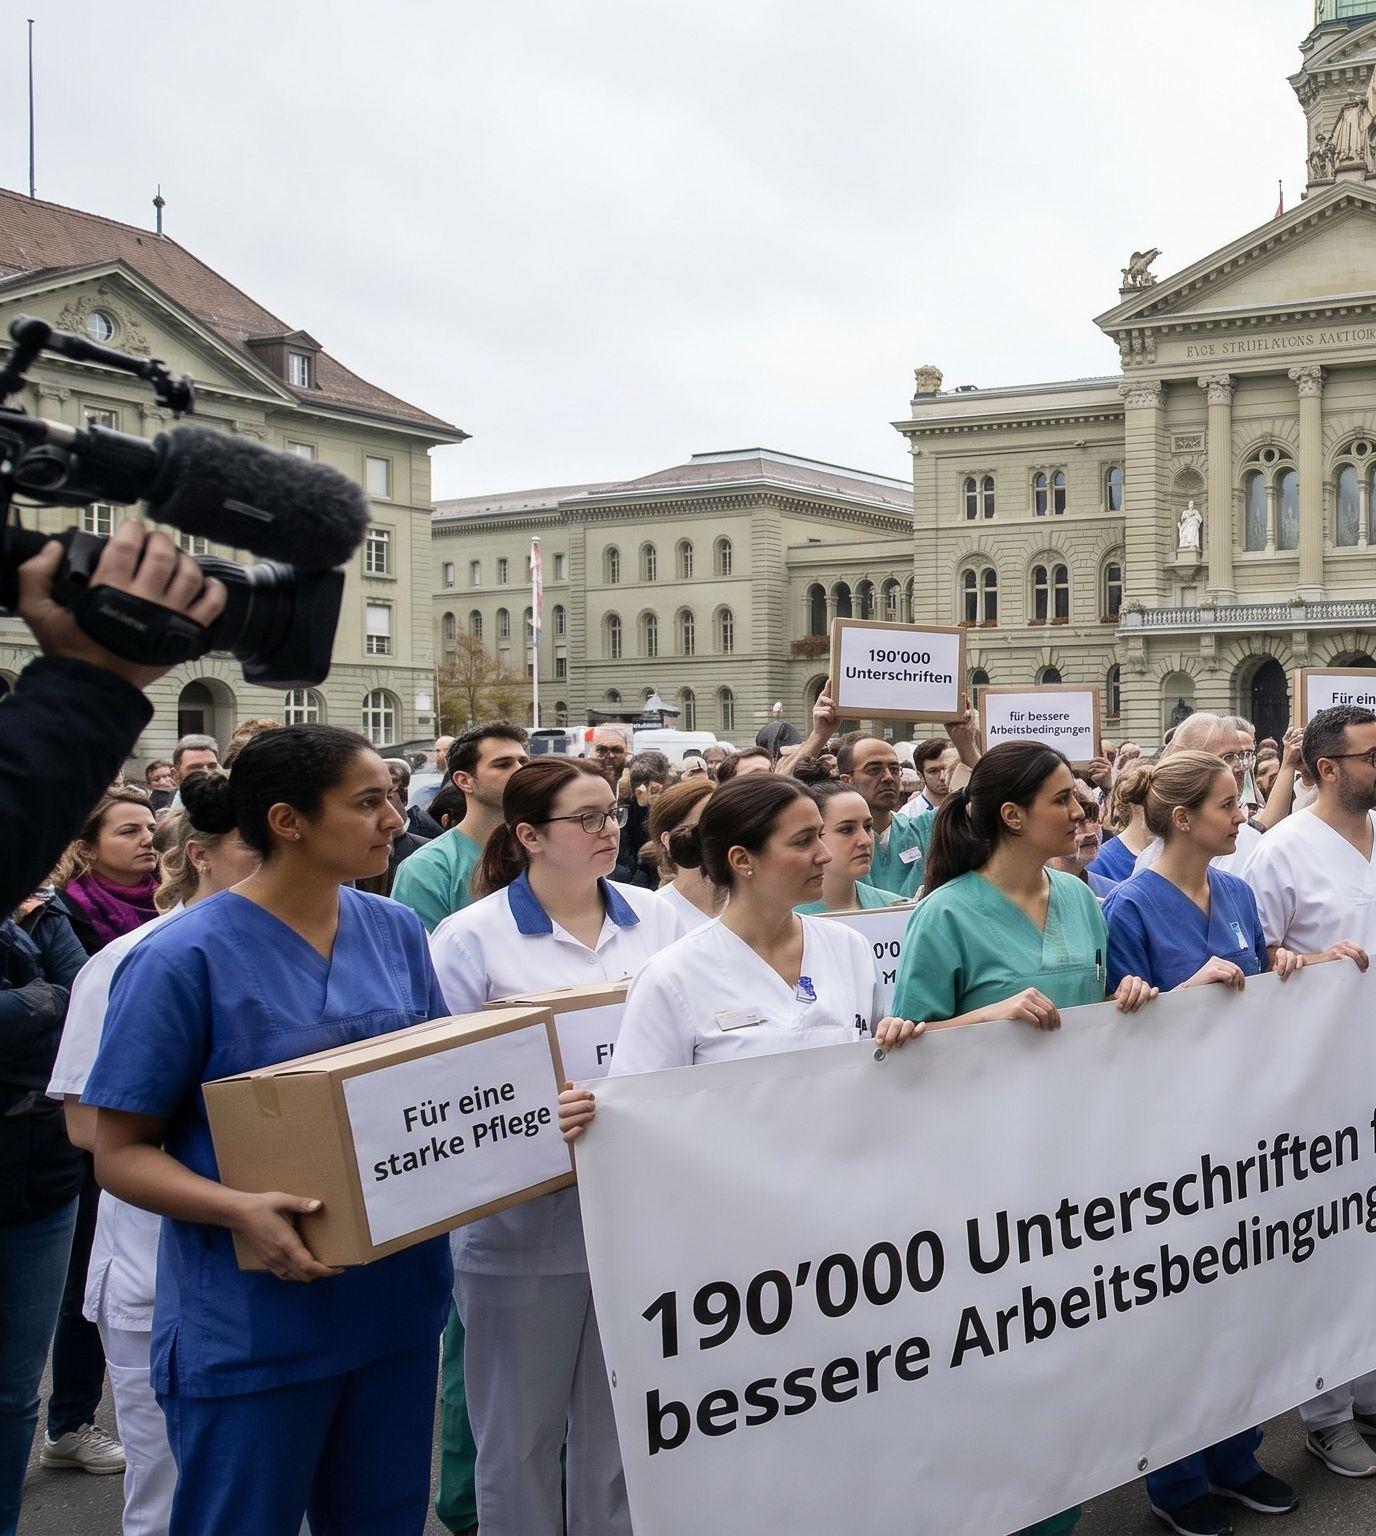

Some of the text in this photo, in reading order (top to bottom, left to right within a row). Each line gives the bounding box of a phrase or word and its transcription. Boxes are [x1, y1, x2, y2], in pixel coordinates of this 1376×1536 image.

[868, 649, 931, 665] 190'000
[845, 666, 953, 684] Unterschriften
[1332, 692, 1353, 704] Für
[1010, 711, 1070, 722] für bessere
[990, 725, 1091, 737] Arbeitsbedingungen
[403, 1082, 515, 1133] Für eine
[373, 1106, 551, 1182] starke Pflege
[966, 1125, 1359, 1275] Unterschriften
[646, 1331, 931, 1456] bessere
